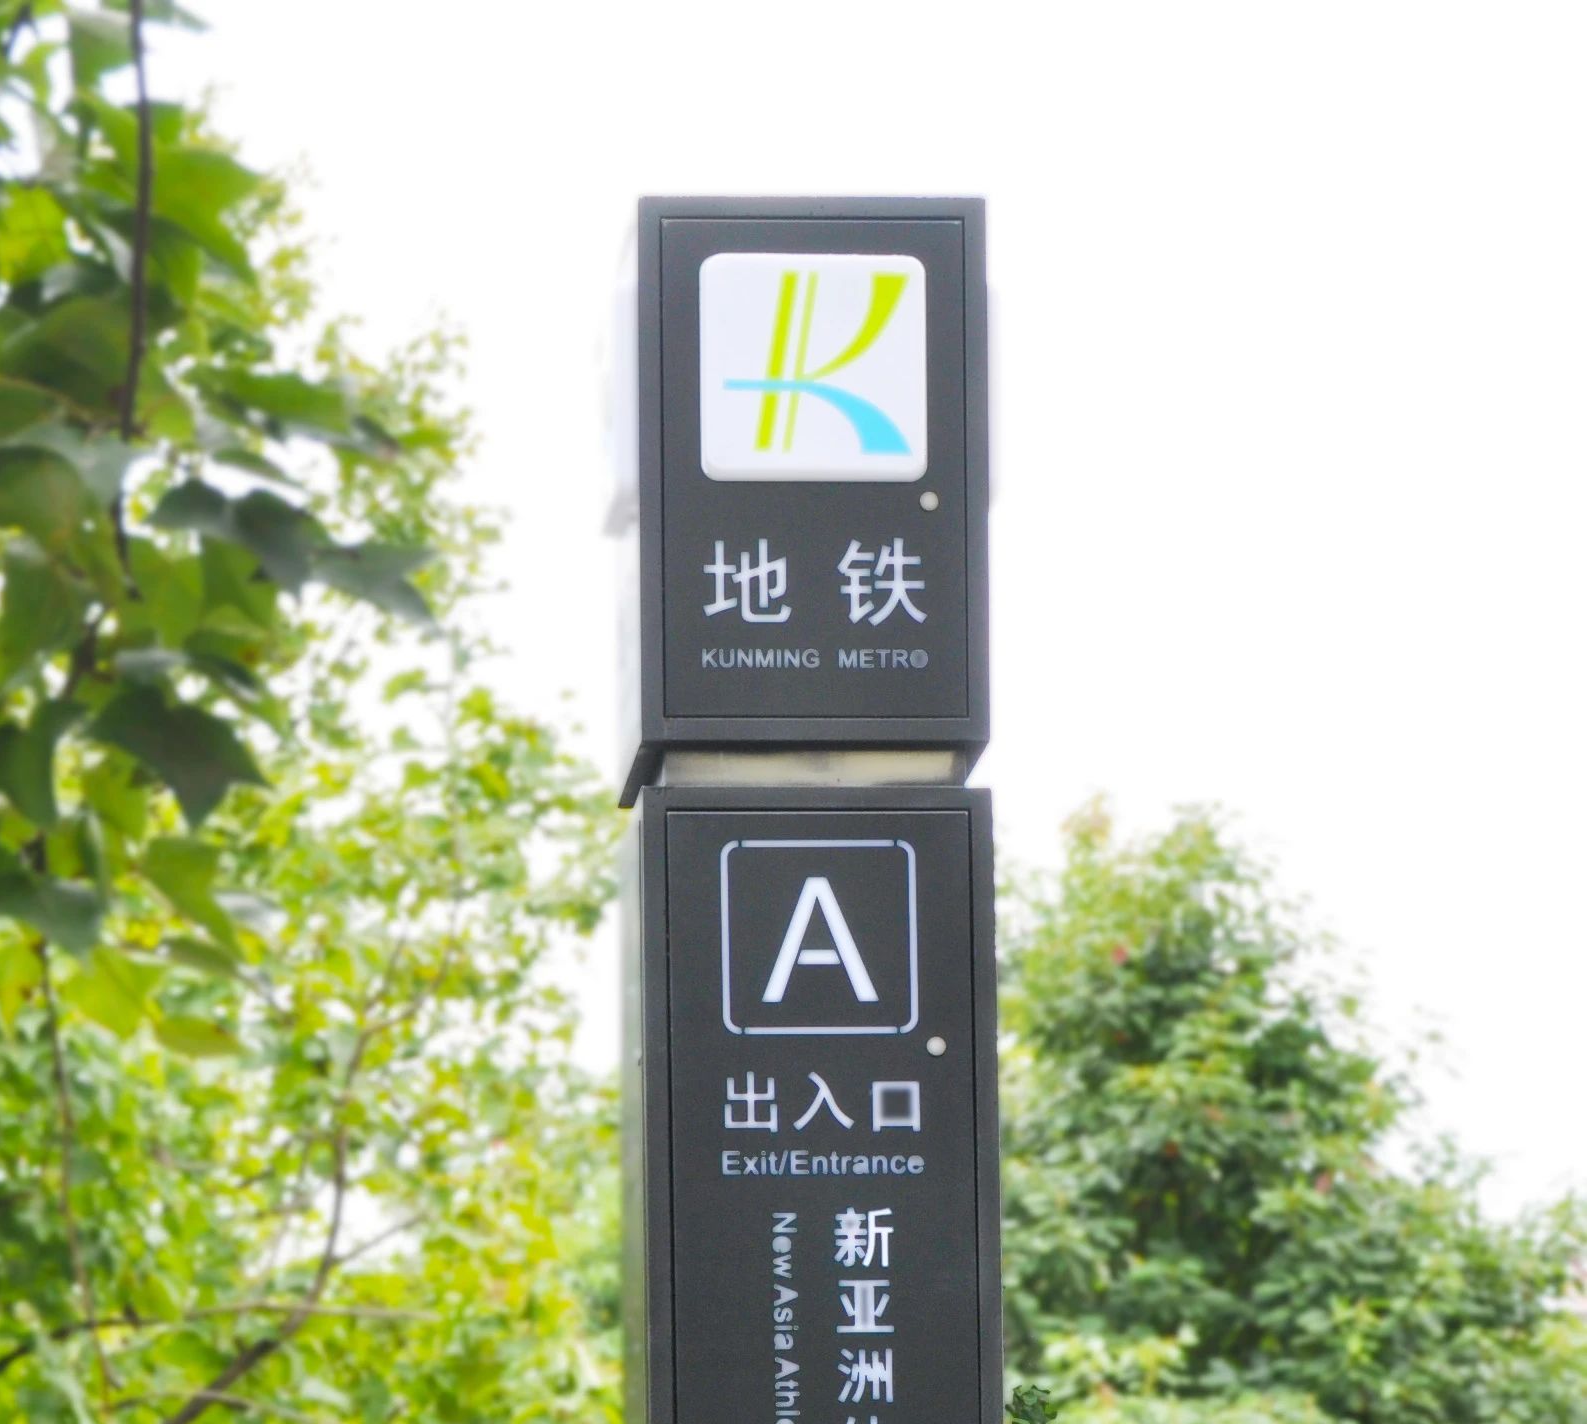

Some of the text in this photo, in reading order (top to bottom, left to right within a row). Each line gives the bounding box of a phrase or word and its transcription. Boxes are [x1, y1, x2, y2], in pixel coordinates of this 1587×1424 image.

[702, 536, 929, 627] 地铁
[701, 647, 930, 670] KUNMING METRO
[761, 875, 880, 1004] A
[723, 1070, 922, 1133] 出入口
[721, 1149, 926, 1177] Exit/Entrance
[771, 1211, 798, 1279] New
[772, 1282, 800, 1351] Asia
